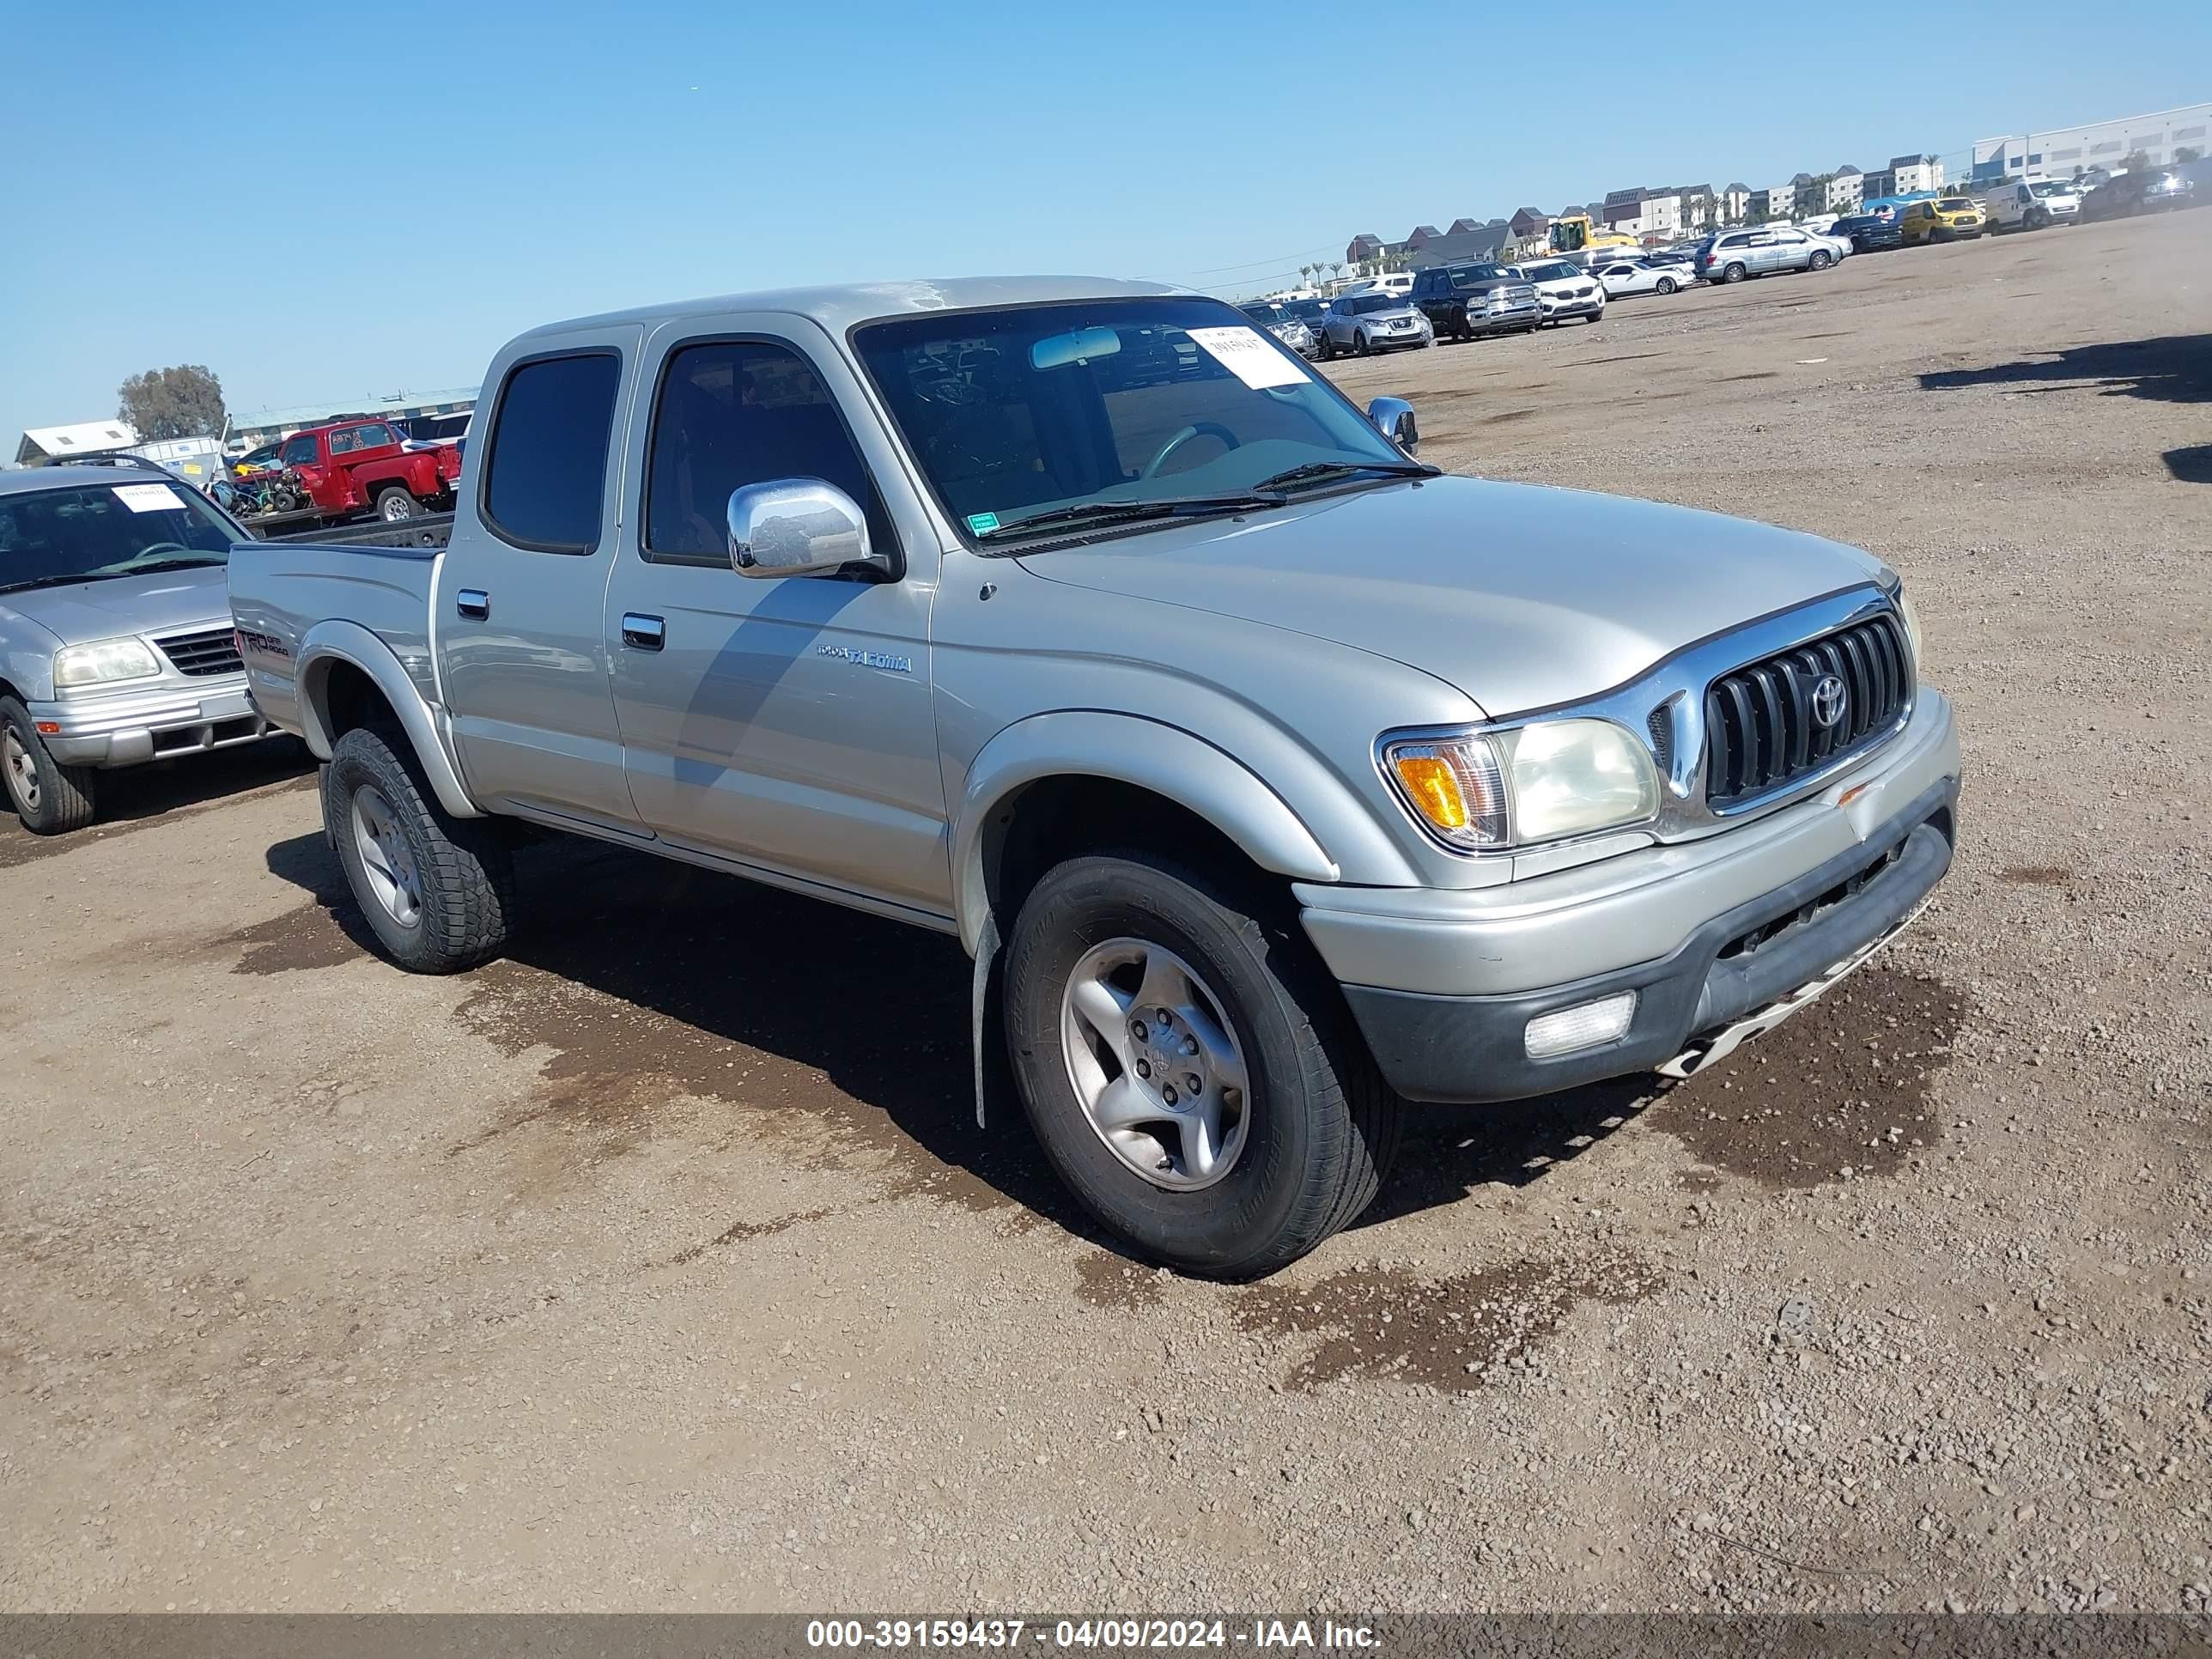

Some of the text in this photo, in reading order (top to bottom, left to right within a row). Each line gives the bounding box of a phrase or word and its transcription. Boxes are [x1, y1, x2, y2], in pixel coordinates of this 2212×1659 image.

[237, 629, 282, 654] TRD OFF
[269, 645, 289, 656] ROAD
[848, 650, 912, 672] TACOMA
